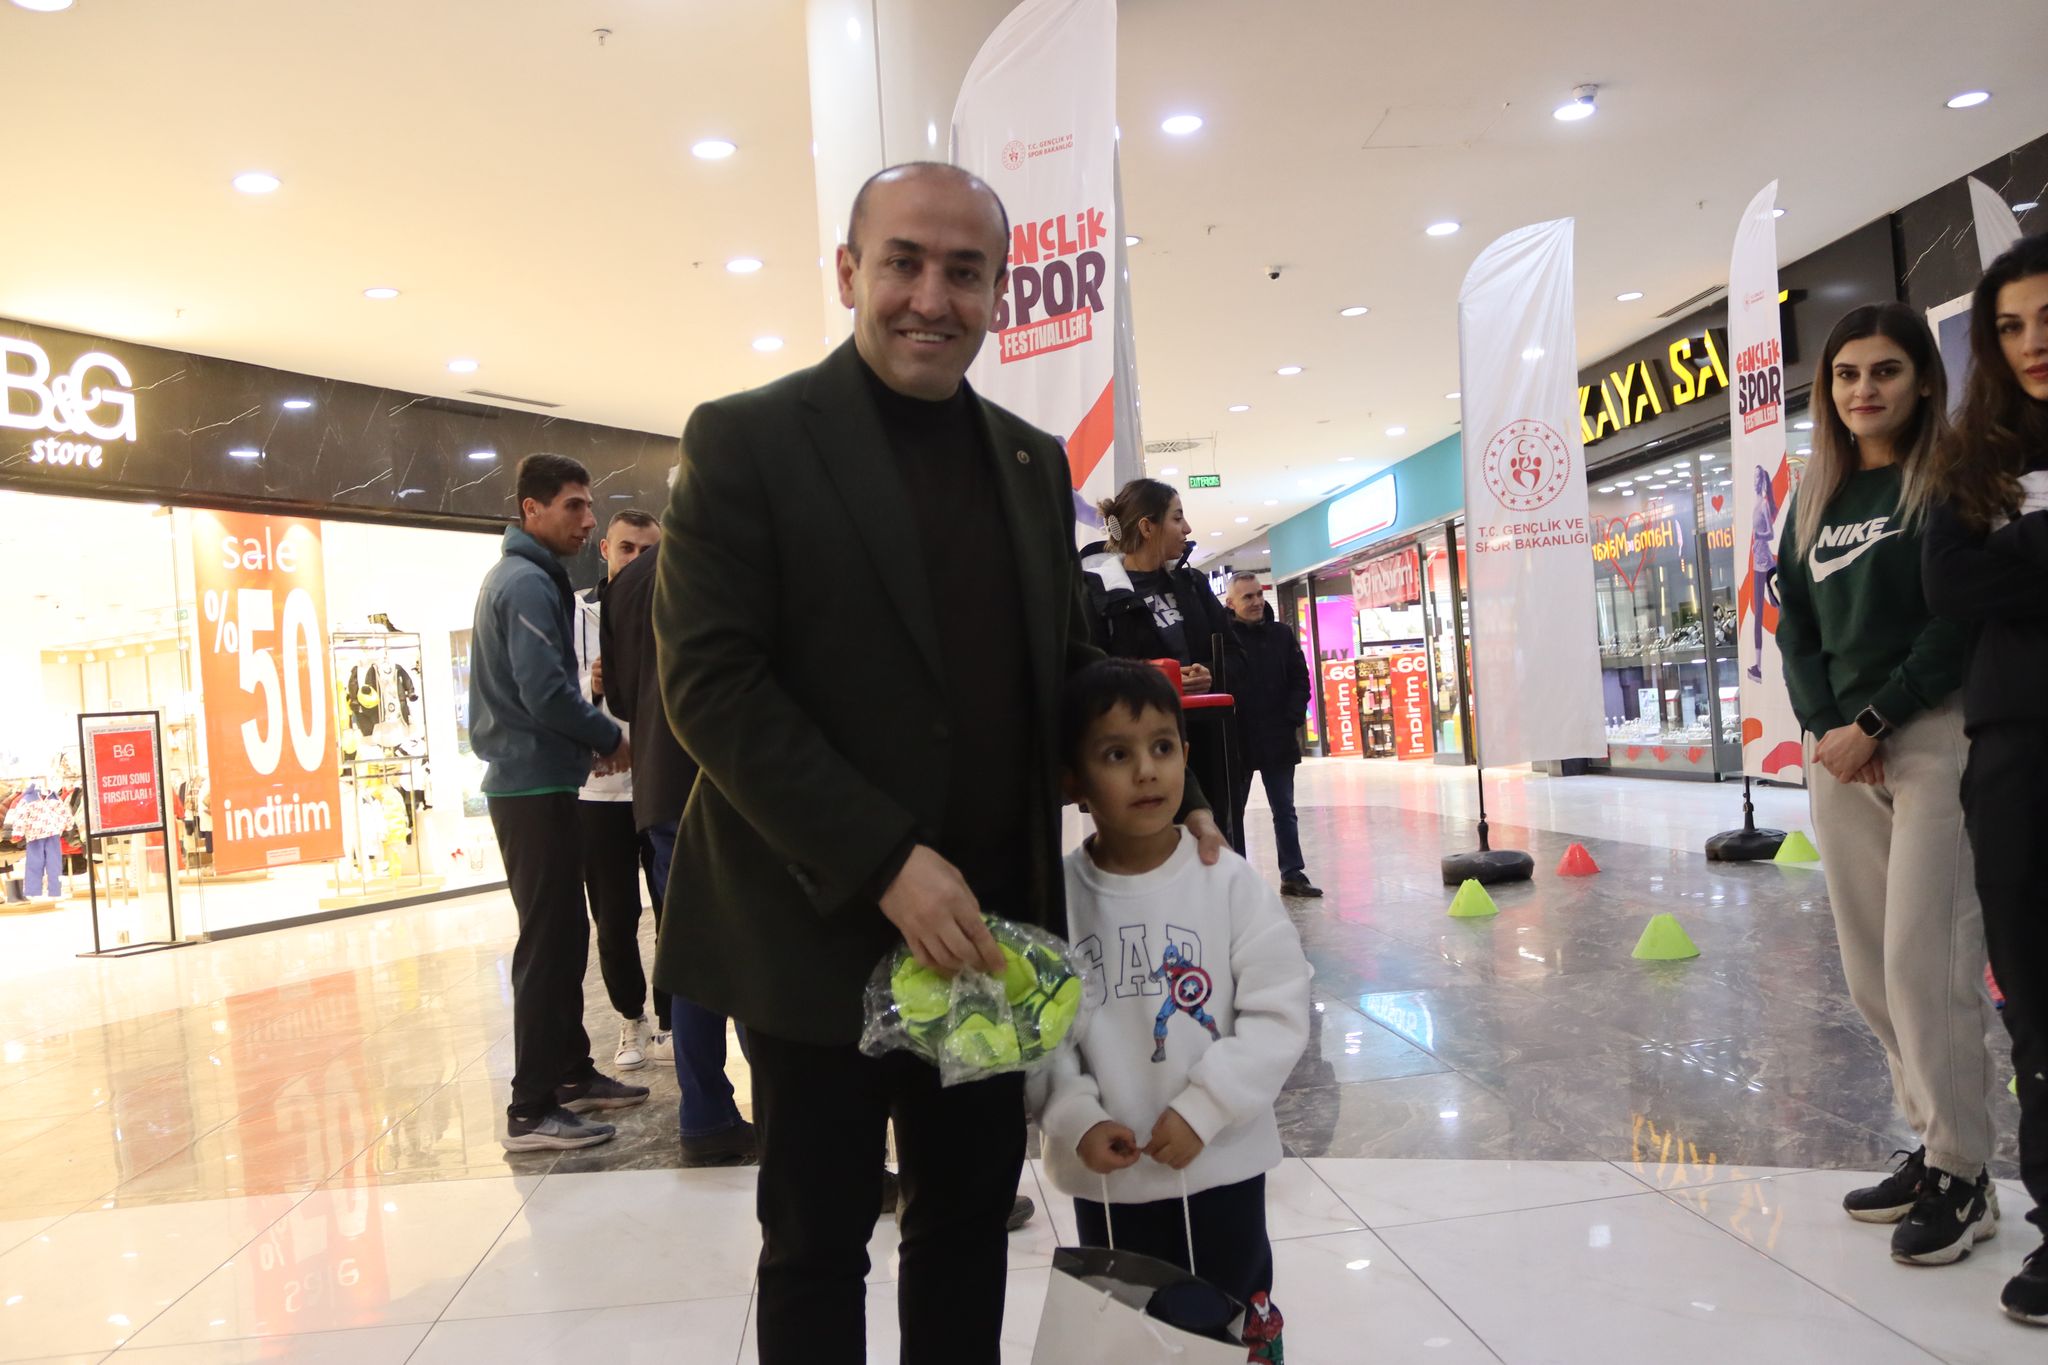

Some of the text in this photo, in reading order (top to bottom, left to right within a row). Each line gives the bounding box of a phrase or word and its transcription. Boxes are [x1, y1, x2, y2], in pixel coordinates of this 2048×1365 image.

[1669, 329, 1729, 406] SA
[0, 336, 137, 441] B&G
[1739, 366, 1781, 415] SPOR
[30, 437, 103, 468] store
[1503, 518, 1561, 536] GENÇLİK
[1565, 518, 1584, 530] VE
[1515, 531, 1589, 550] BAKANLIĞI
[1817, 516, 1890, 549] NIKE
[221, 526, 299, 573] sale
[203, 588, 326, 776] %50
[102, 771, 152, 788] SEZON SONU
[103, 789, 148, 804] FIRSATLARI
[223, 793, 331, 841] indirim
